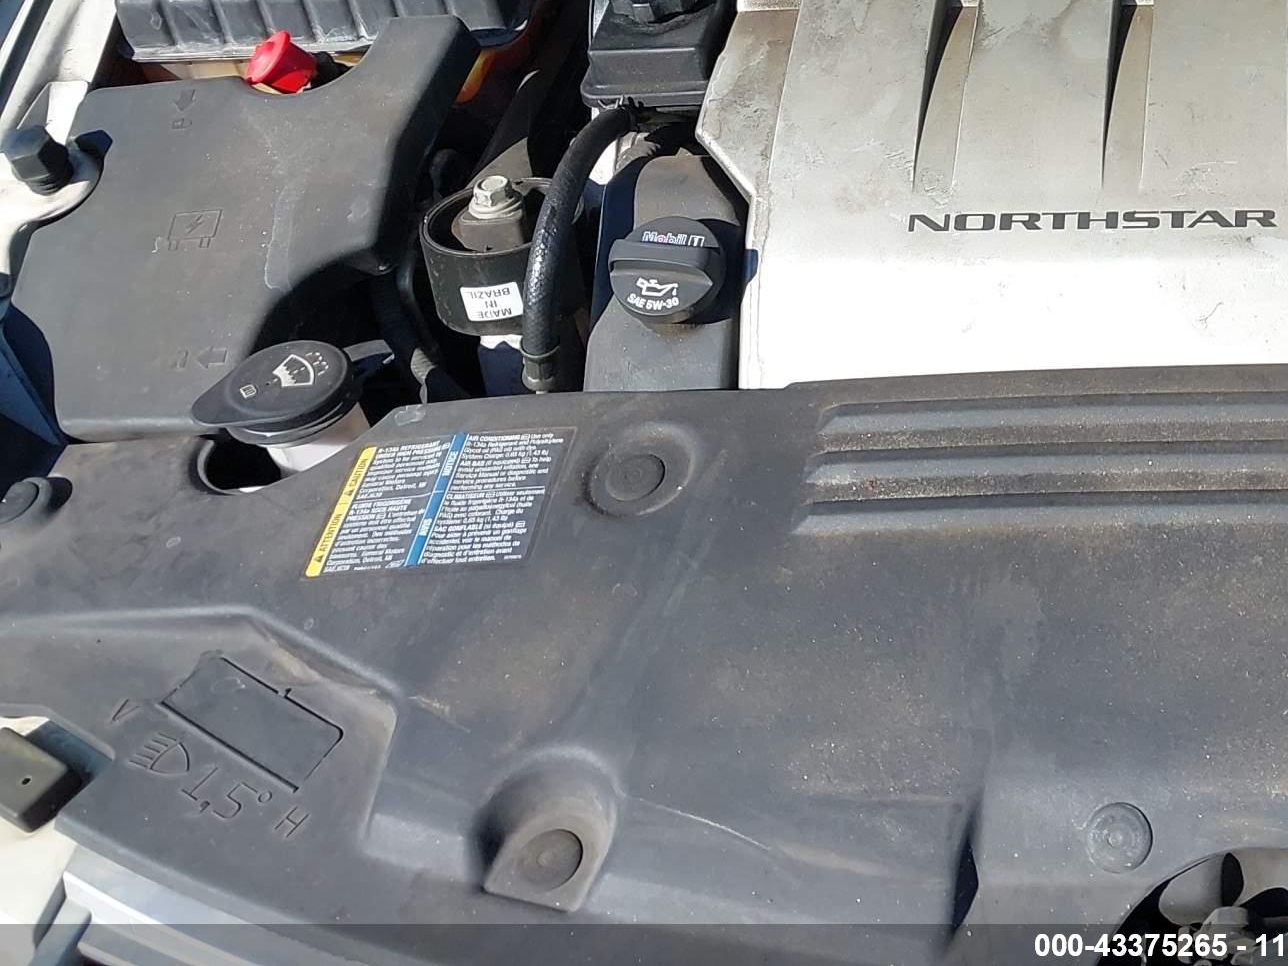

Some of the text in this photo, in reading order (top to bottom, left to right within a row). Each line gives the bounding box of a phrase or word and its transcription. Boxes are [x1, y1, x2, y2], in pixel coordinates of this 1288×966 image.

[908, 208, 1278, 232] NORTHSTAR
[642, 231, 687, 246] Mobil
[465, 287, 511, 299] BRAZIL
[485, 300, 498, 309] IN
[627, 293, 680, 311] SAE 5W-30
[476, 307, 513, 319] MADE
[321, 514, 343, 550] ATTENTION
